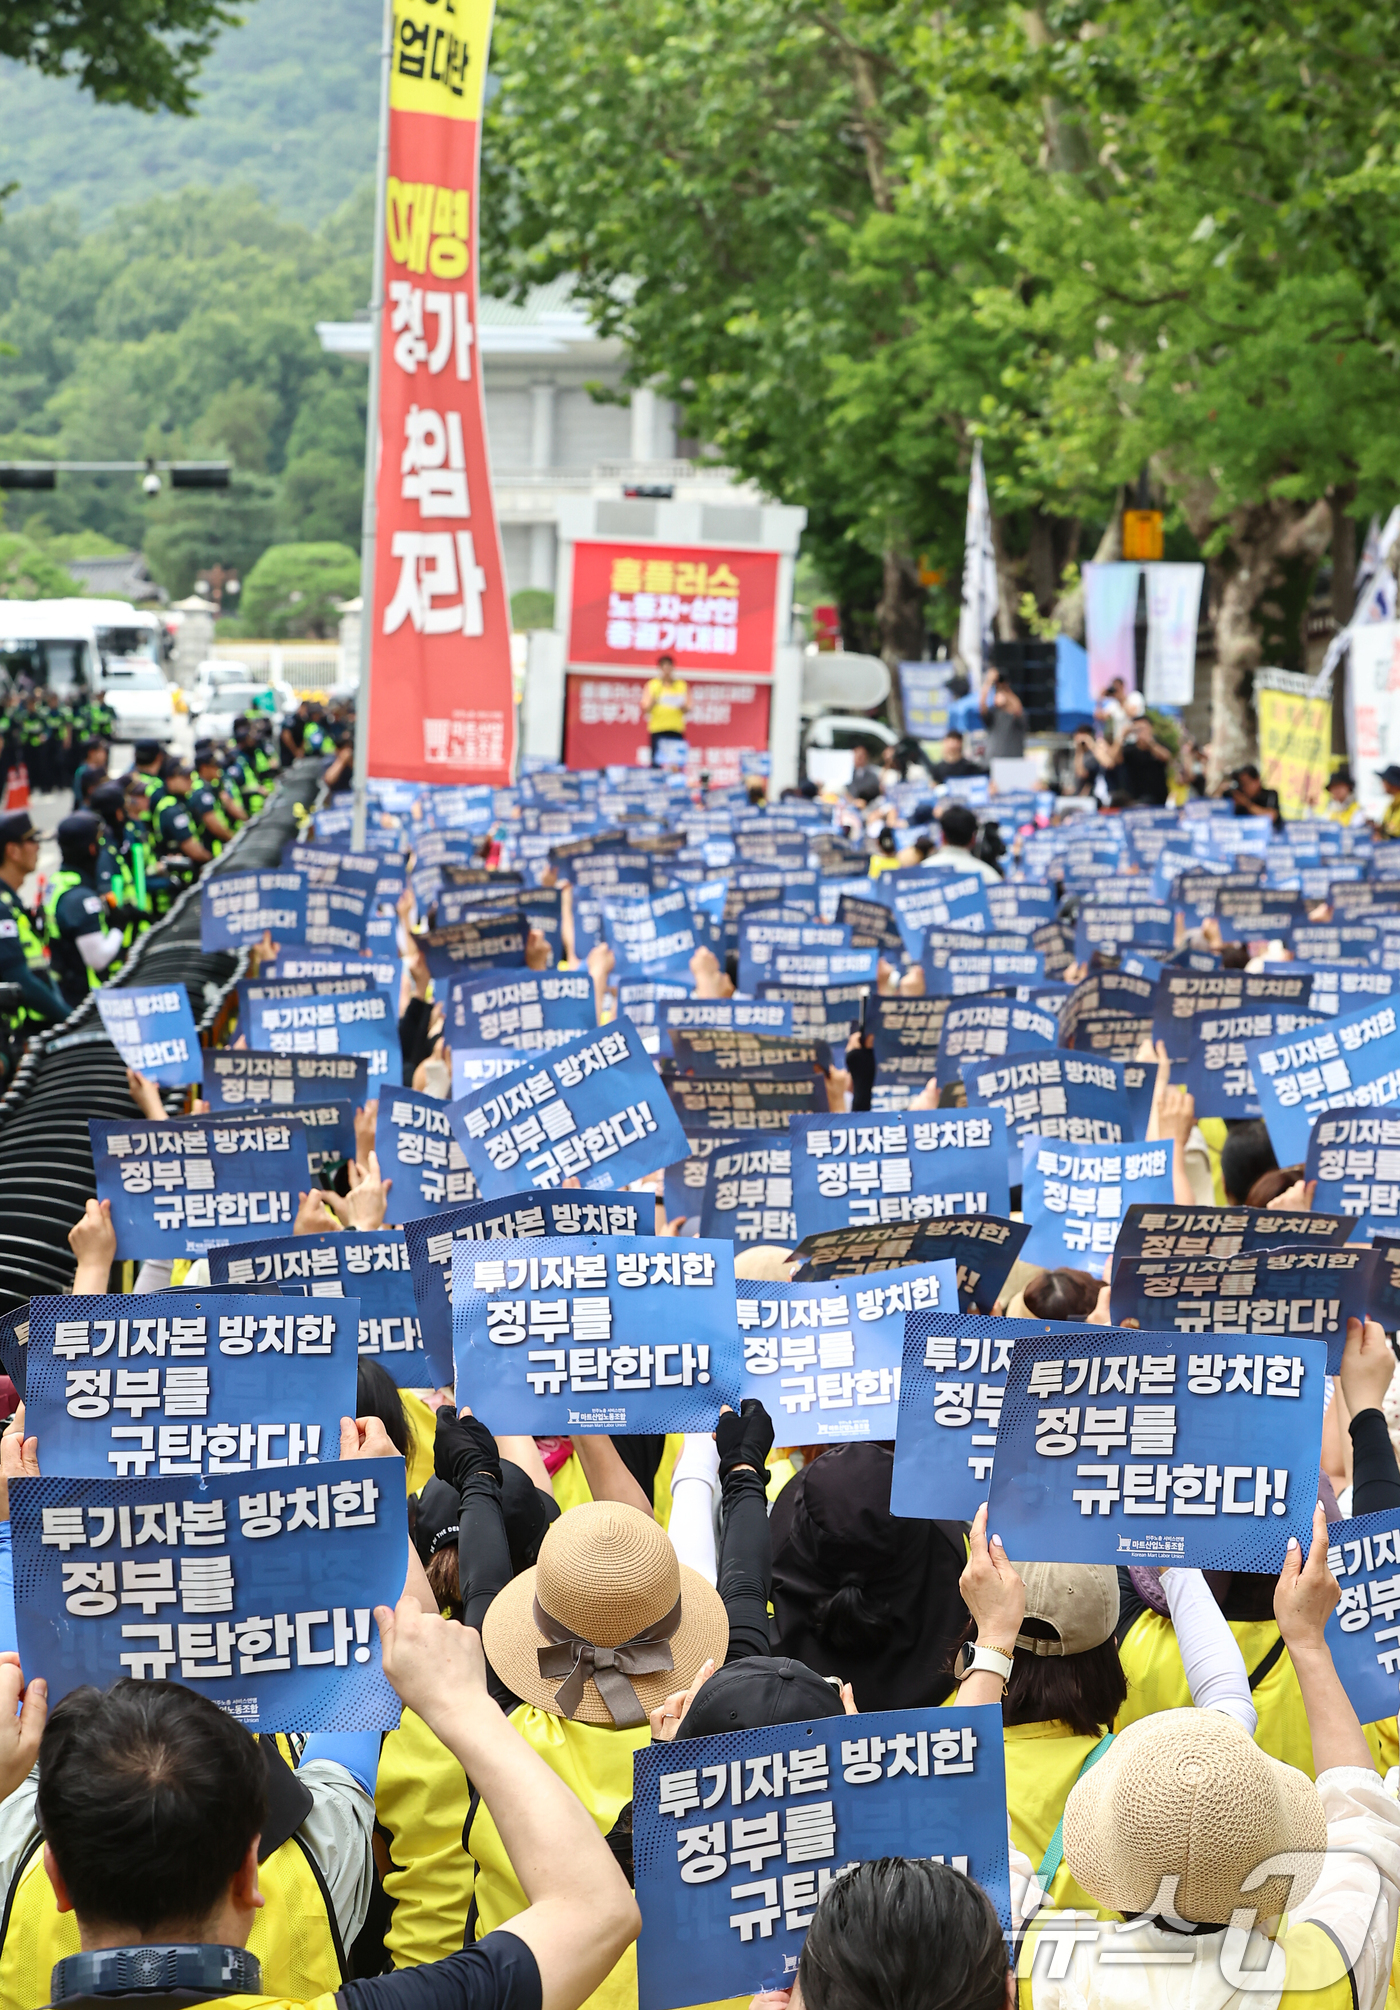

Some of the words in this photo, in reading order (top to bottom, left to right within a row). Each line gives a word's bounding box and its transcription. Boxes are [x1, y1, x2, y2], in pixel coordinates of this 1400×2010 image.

[389, 280, 475, 380] 정가
[612, 557, 739, 596] 홈플러스
[135, 991, 180, 1016] 방치한
[471, 980, 539, 1014] 투기자본
[541, 978, 589, 1000] 방치한
[1169, 977, 1242, 994] 투기자본
[1246, 979, 1303, 996] 방치한
[262, 1004, 335, 1030] 투기자본
[337, 998, 386, 1023] 방치한
[479, 1003, 543, 1040] 정부를
[667, 1006, 732, 1026] 투기자본
[735, 1006, 785, 1026] 방치한
[947, 1006, 1010, 1030] 투기자본
[1200, 1014, 1272, 1041] 투기자본
[270, 1028, 339, 1054] 정부를
[1205, 1043, 1247, 1070] 정부
[1258, 1032, 1339, 1076] 투기자본
[1339, 1007, 1397, 1051] 방치한
[214, 1057, 293, 1078] 투기자본
[297, 1059, 357, 1079] 방치한
[463, 1070, 557, 1139] 투기자본
[553, 1031, 630, 1088] 방치한
[977, 1059, 1062, 1098] 투기자본
[1064, 1060, 1117, 1091] 방치한
[1272, 1058, 1351, 1107] 정부를
[221, 1079, 295, 1104] 정부를
[390, 1101, 450, 1136] 투기자
[484, 1098, 577, 1171] 정부를
[806, 1124, 907, 1157] 투기자본
[913, 1118, 992, 1151] 방치한
[1317, 1119, 1400, 1146] 투기자본
[107, 1130, 207, 1158] 투기자본
[214, 1126, 290, 1154] 방치한
[525, 1101, 657, 1189] 규탄한다!
[120, 1160, 215, 1193] 정부를
[714, 1150, 791, 1179] 투기자본
[817, 1157, 911, 1197] 정부를
[1036, 1150, 1121, 1183] 투기자본
[1125, 1150, 1167, 1180] 방치한
[154, 1191, 291, 1230] 규탄한다!
[715, 1178, 793, 1210] 정부를
[1043, 1180, 1122, 1219] 정부를
[552, 1203, 638, 1236] 방치한
[811, 1224, 920, 1248] 투기자본
[924, 1221, 1010, 1245] 방치한
[1138, 1213, 1249, 1233] 투기자본
[1254, 1216, 1339, 1235] 방치한
[227, 1247, 338, 1285] 투기자본
[345, 1244, 410, 1272] 방치
[811, 1240, 912, 1265] 정부를
[1136, 1257, 1258, 1275] 투기자본
[1266, 1253, 1360, 1270] 방치한
[1141, 1235, 1244, 1259] 정부를
[473, 1254, 607, 1293] 투기자본
[616, 1252, 715, 1287] 방치한
[1143, 1274, 1256, 1297] 정부를
[486, 1296, 612, 1345] 정부를
[736, 1295, 849, 1331] 투기자본
[856, 1275, 940, 1322] 방치한
[1174, 1299, 1340, 1334] 규탄한다!
[52, 1316, 207, 1360] 투기자본
[218, 1314, 336, 1355] 방치한
[358, 1316, 424, 1352] 한다!
[743, 1330, 855, 1375] 정부를
[526, 1344, 710, 1395] 규탄한다!
[1027, 1355, 1176, 1399] 투기자본
[1187, 1354, 1304, 1398] 방치한
[65, 1366, 210, 1419] 정부를
[779, 1367, 901, 1414] 규탄한
[934, 1382, 1005, 1427] 정부
[580, 1413, 626, 1421] 마트산업노동조합
[1035, 1405, 1177, 1456] 정부를
[108, 1423, 321, 1476] 규탄한다!
[1072, 1463, 1289, 1516] 규탄한다!
[41, 1500, 226, 1551] 투기자본
[238, 1479, 379, 1538] 방치한
[1132, 1540, 1184, 1551] 마트산업노동조합
[1327, 1529, 1400, 1579] 투기자
[62, 1555, 234, 1616] 정부를
[1335, 1574, 1400, 1632] 정부
[120, 1608, 371, 1679] 규탄한다!
[658, 1744, 829, 1818] 투기자본
[841, 1727, 977, 1784] 방치한
[677, 1800, 836, 1884] 정부를
